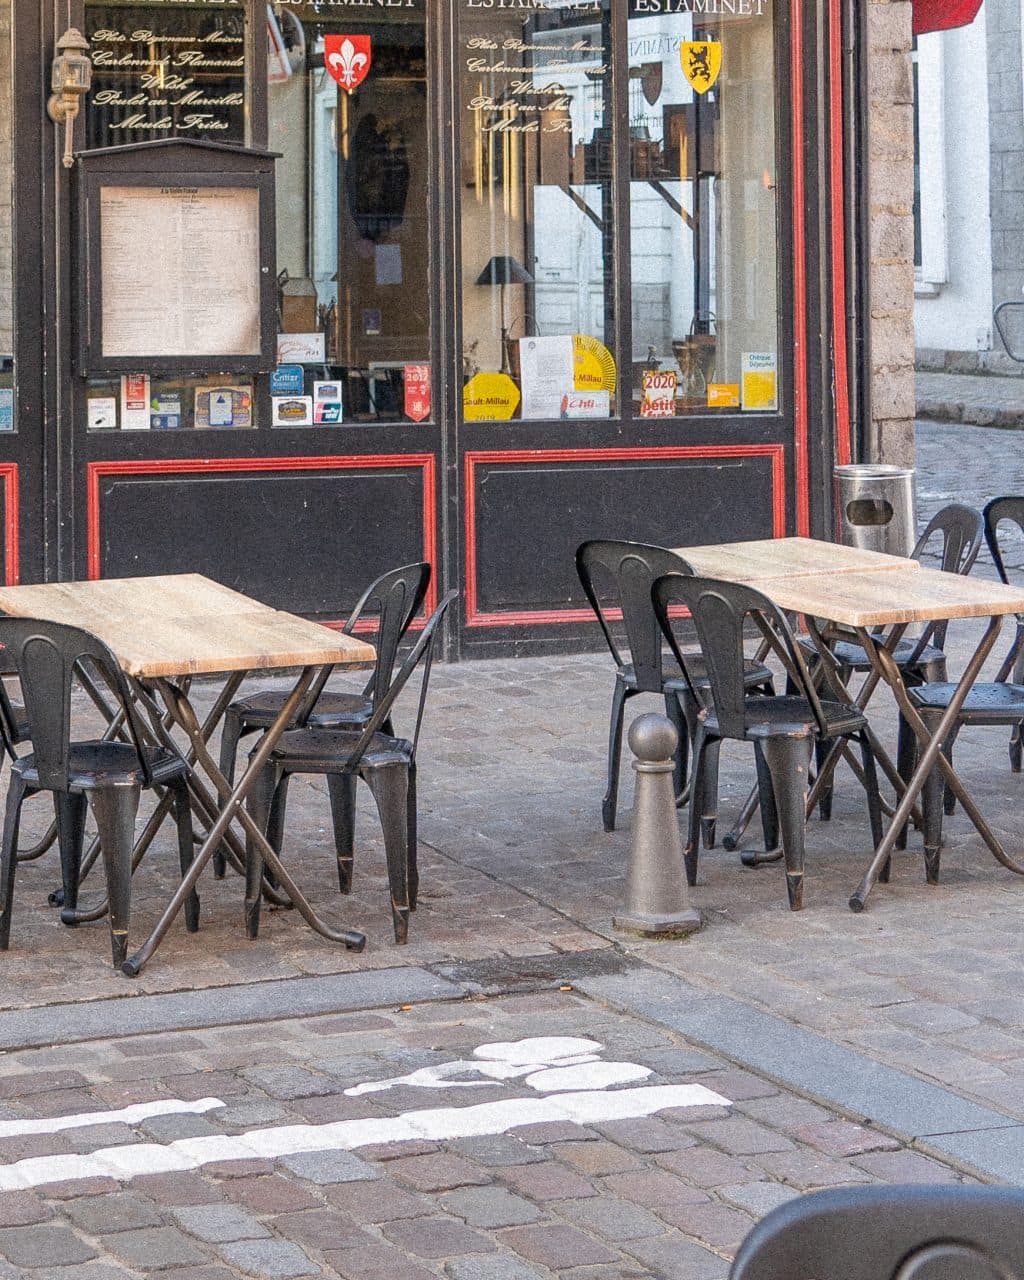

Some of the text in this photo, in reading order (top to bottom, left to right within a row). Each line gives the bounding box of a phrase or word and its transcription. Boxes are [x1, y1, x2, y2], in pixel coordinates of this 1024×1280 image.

[91, 29, 126, 42] Plats
[197, 30, 243, 43] Maison
[91, 50, 245, 66] Carbonnade Flamande
[140, 73, 193, 89] Welsh
[92, 89, 149, 105] Poulet
[109, 113, 229, 129] Moules Frites
[578, 375, 602, 383] Millau
[645, 375, 674, 389] 2020
[643, 400, 674, 413] petit
